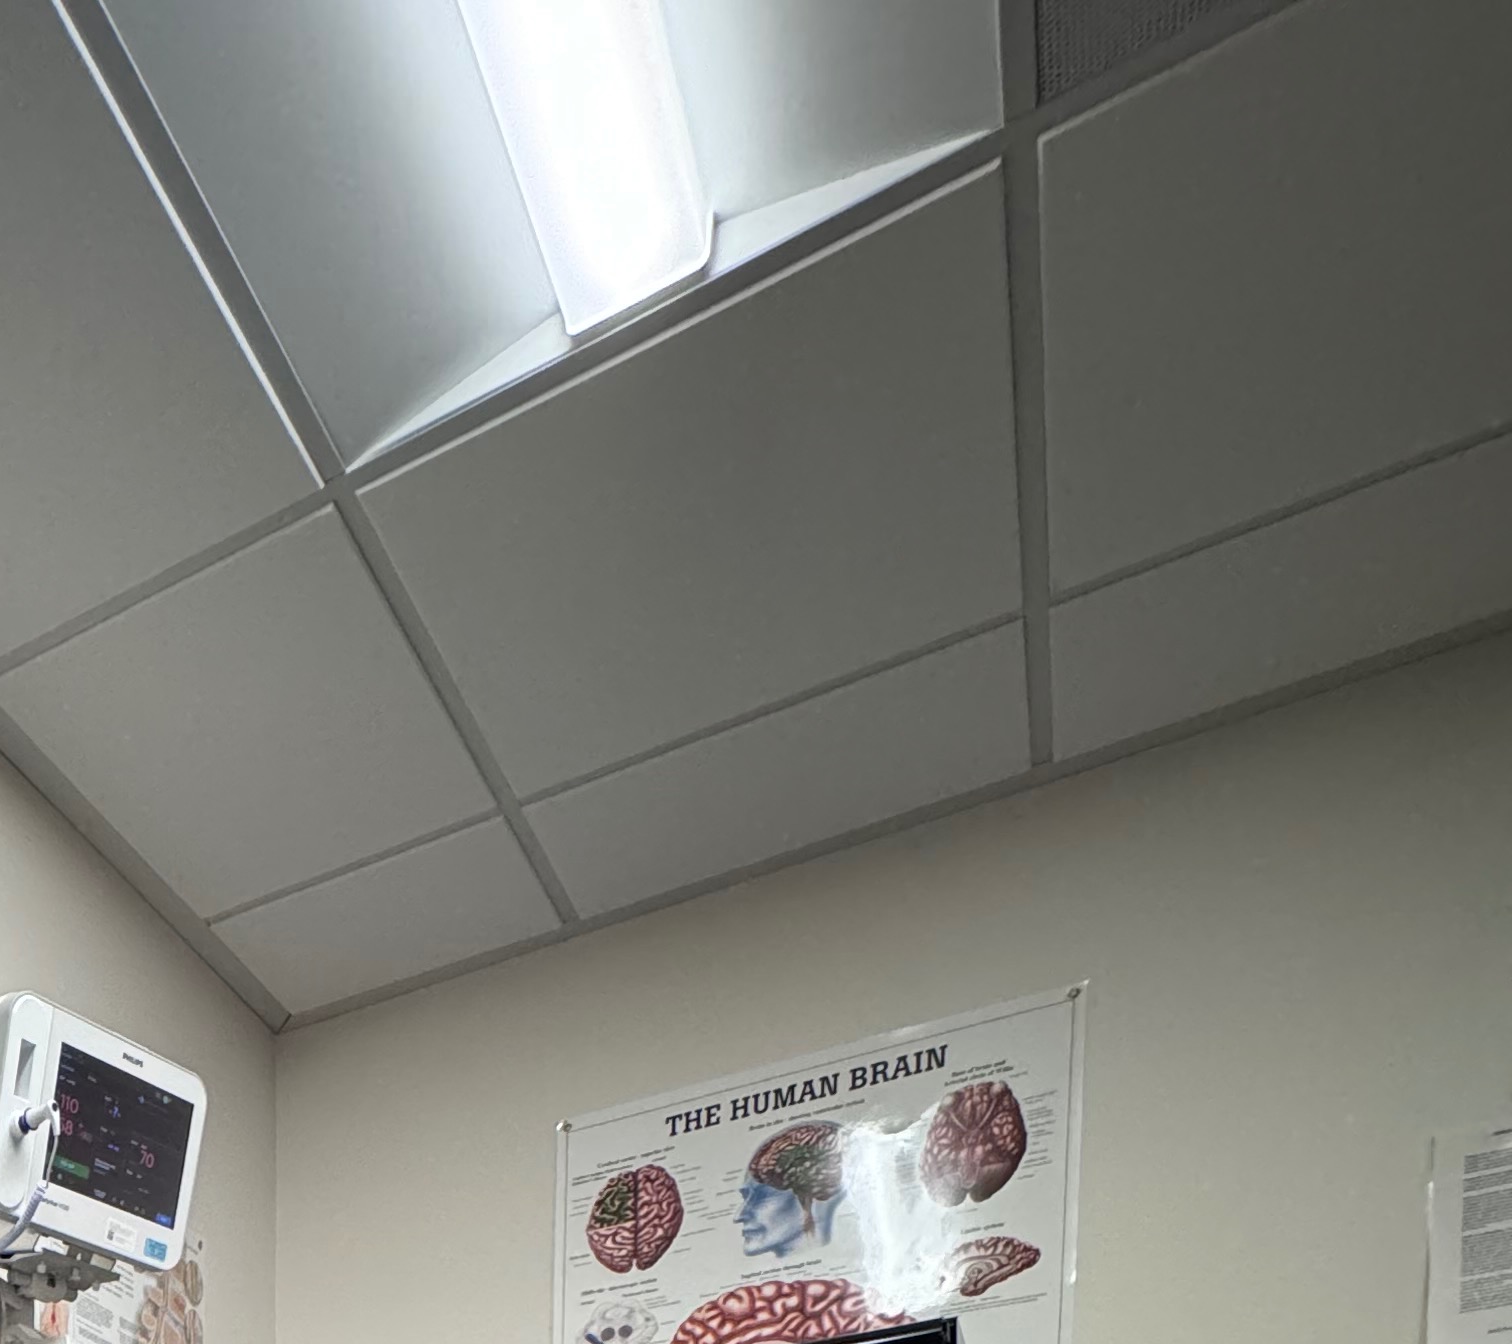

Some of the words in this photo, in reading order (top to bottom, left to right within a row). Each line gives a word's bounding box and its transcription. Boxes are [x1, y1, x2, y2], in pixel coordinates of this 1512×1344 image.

[665, 1104, 721, 1138] THE
[729, 1072, 840, 1123] HUMAN
[847, 1044, 949, 1093] BRAIN
[140, 1150, 155, 1168] 70
